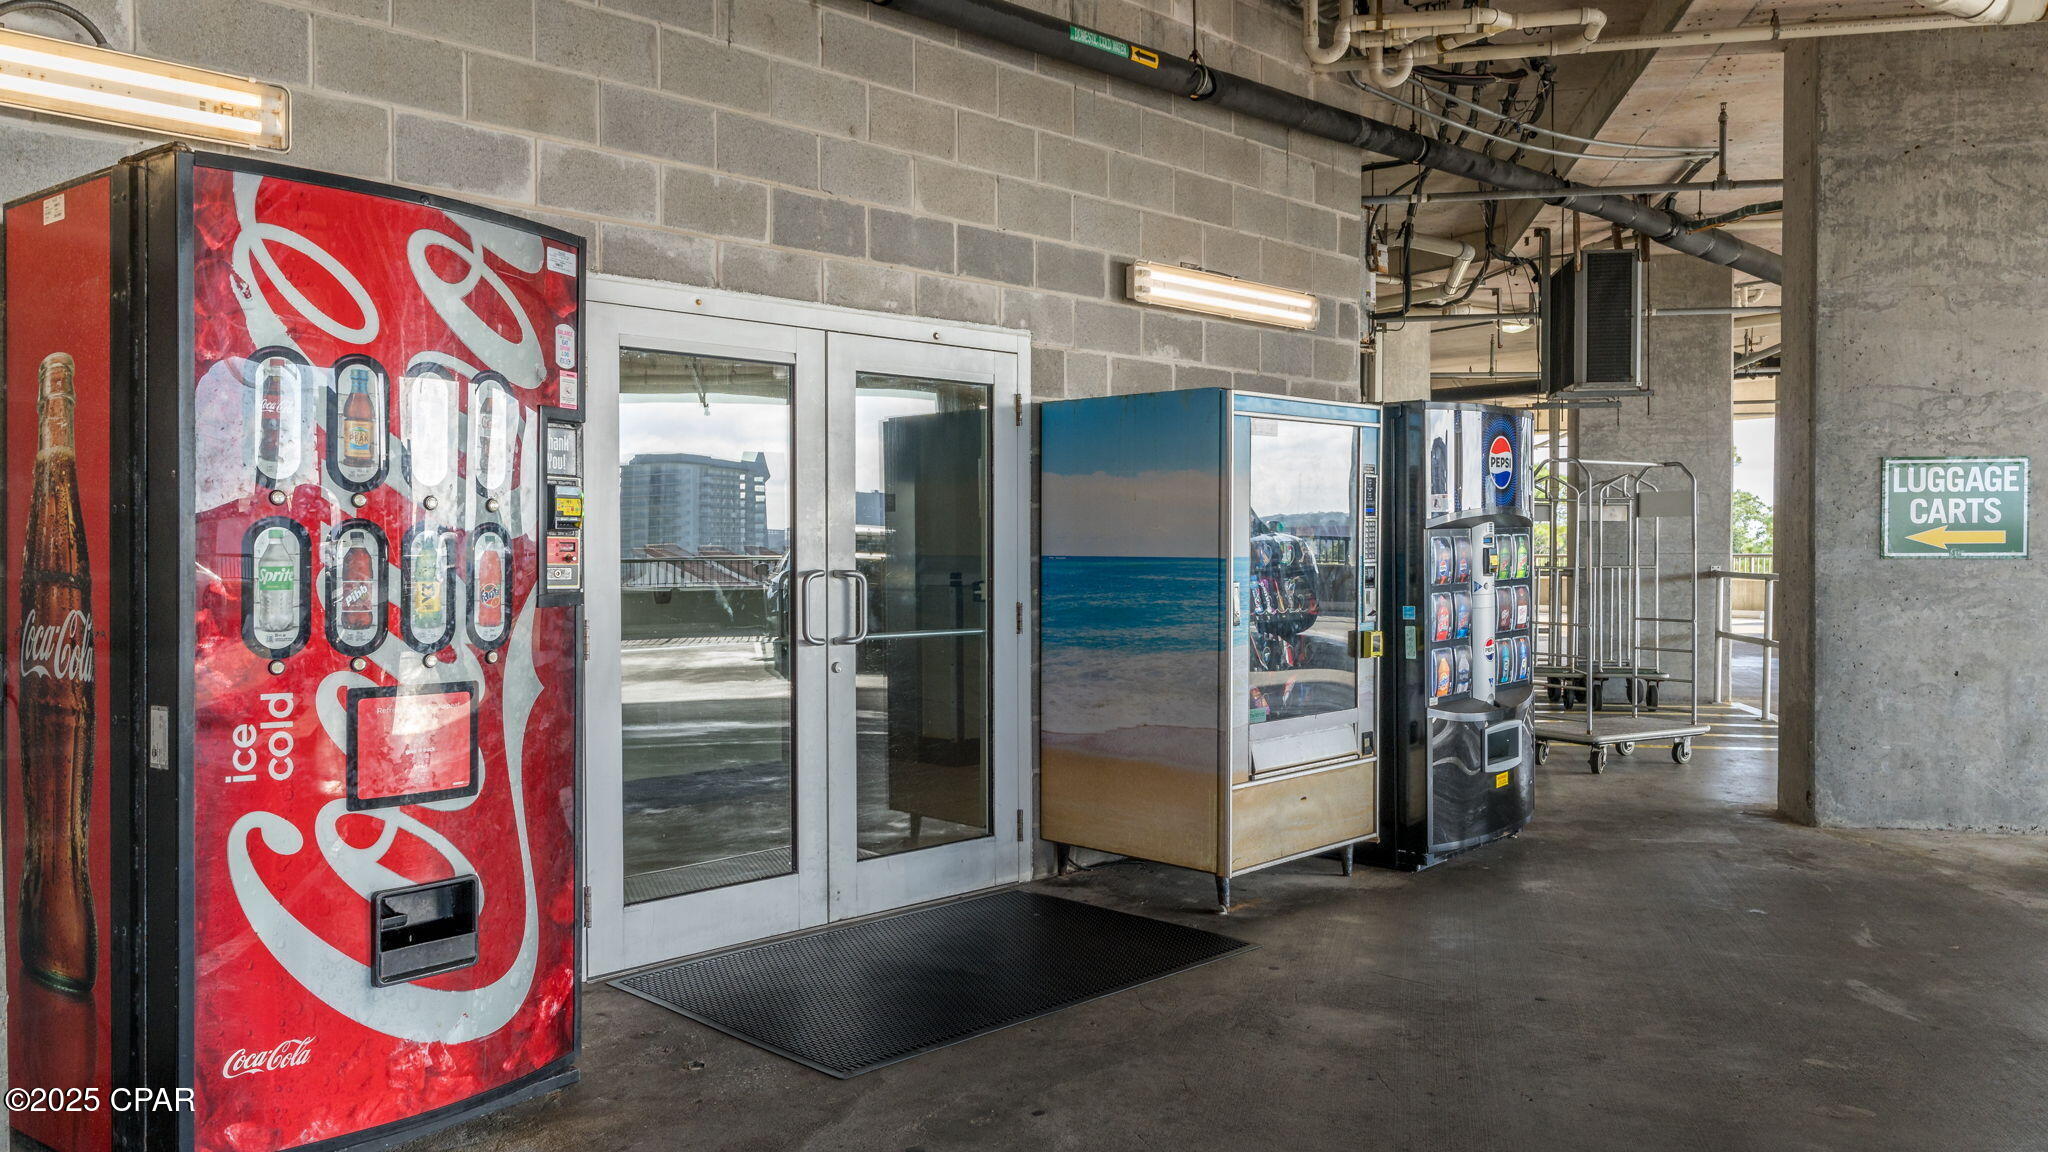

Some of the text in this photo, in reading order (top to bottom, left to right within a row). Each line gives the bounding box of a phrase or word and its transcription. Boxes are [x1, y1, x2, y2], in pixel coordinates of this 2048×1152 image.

[1099, 35, 1112, 50] COLD
[548, 453, 566, 470] You!
[1490, 456, 1512, 469] PEPSI
[1893, 466, 2020, 493] LUGGAGE
[1910, 498, 2002, 524] CARTS
[20, 608, 94, 682] Coca-Cola
[260, 692, 294, 781] cold
[225, 723, 257, 783] ice
[223, 1036, 317, 1079] Coca-Cola
